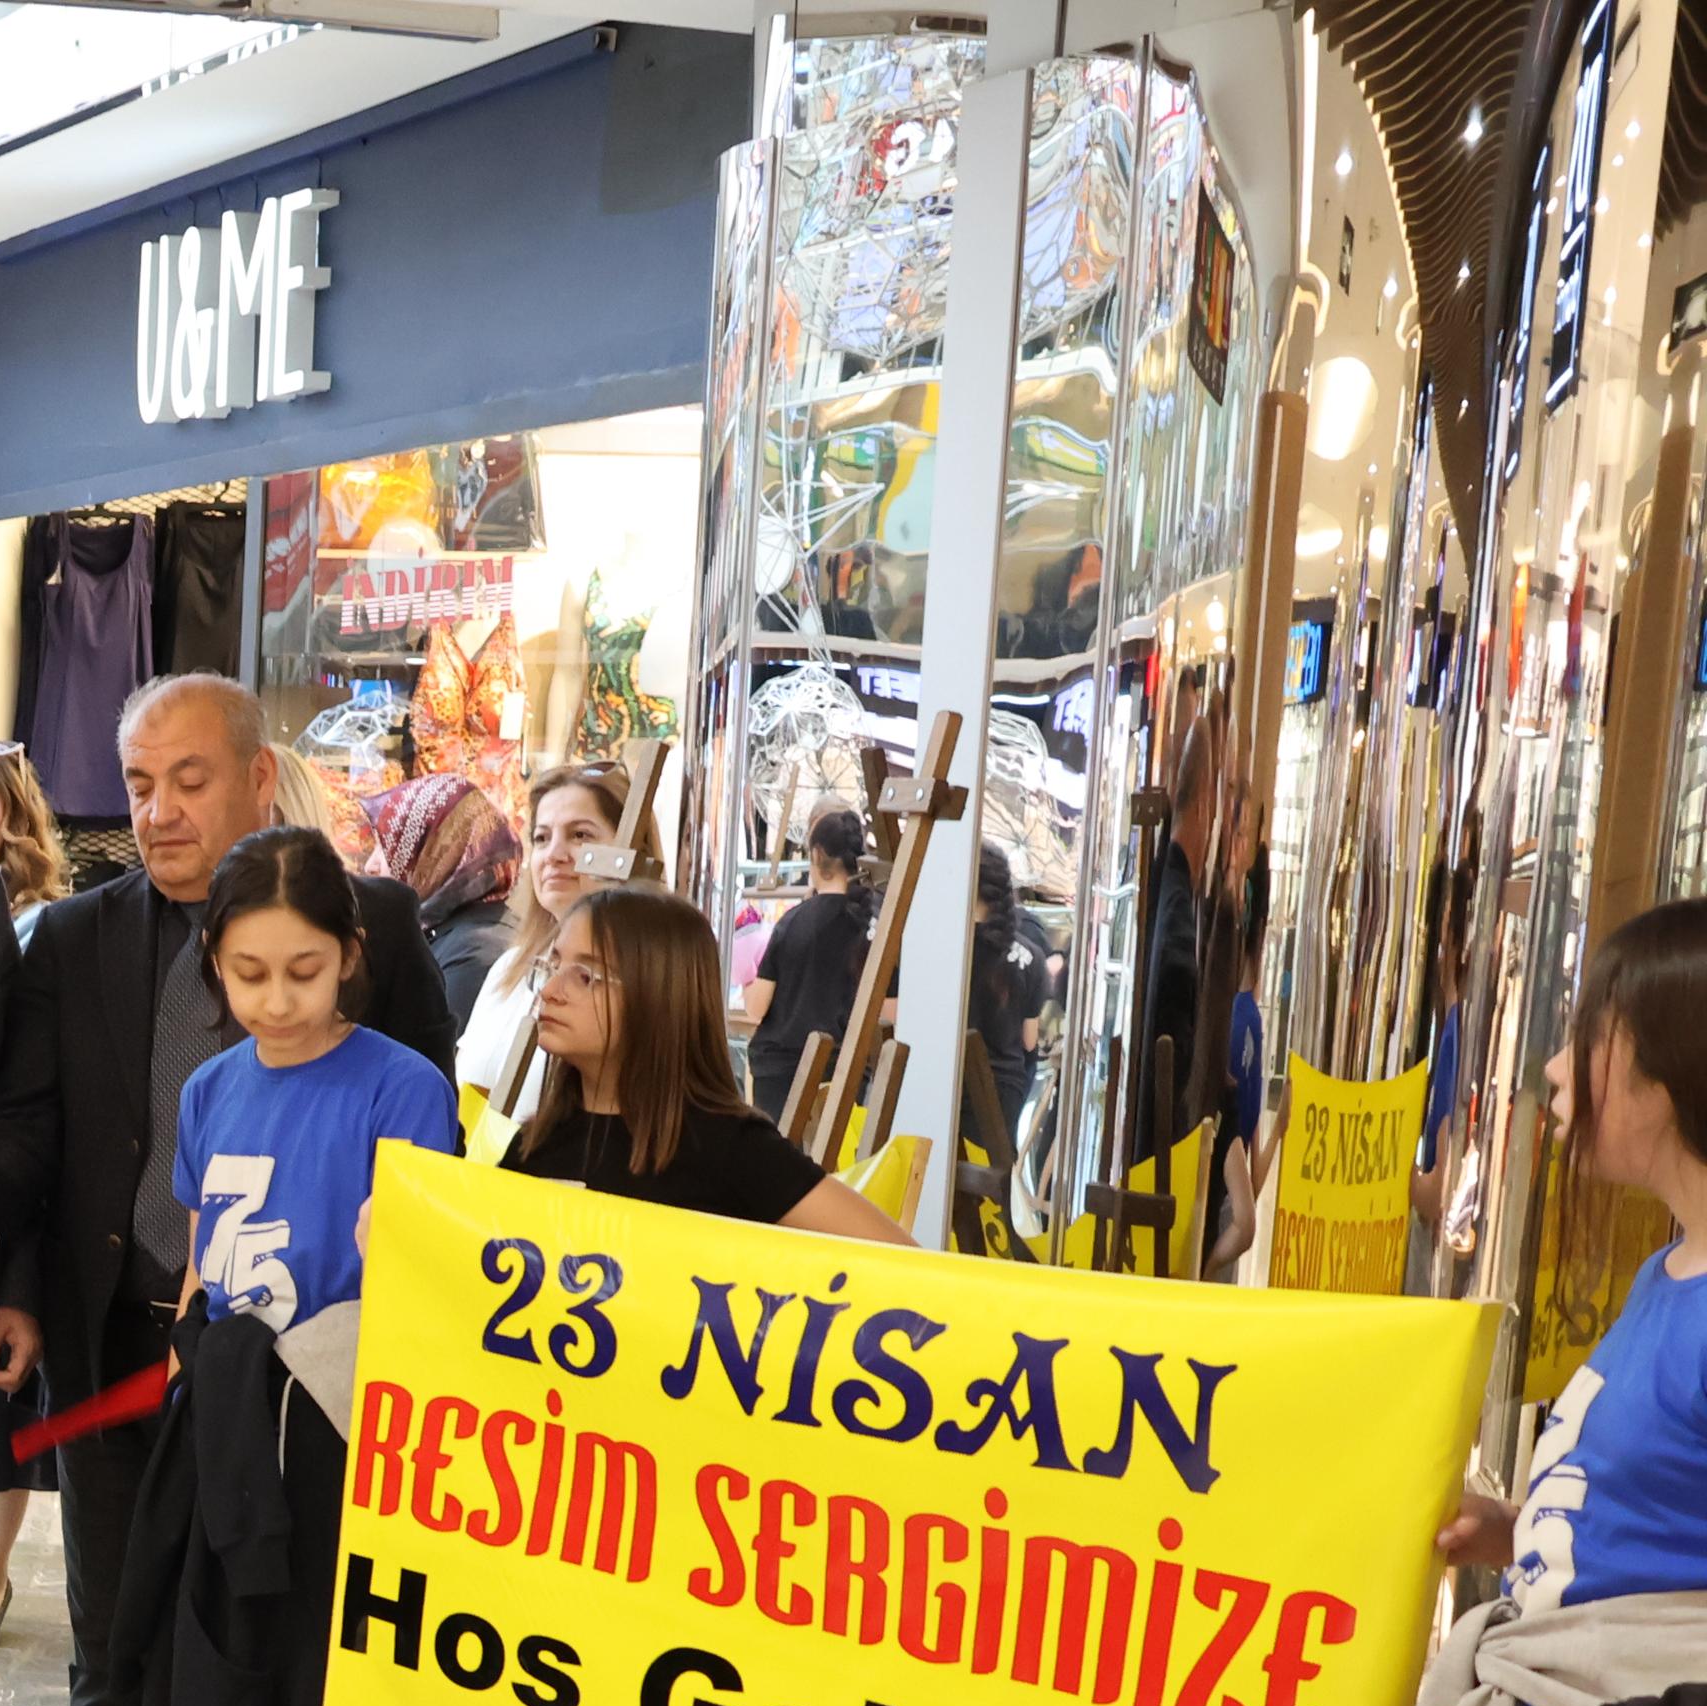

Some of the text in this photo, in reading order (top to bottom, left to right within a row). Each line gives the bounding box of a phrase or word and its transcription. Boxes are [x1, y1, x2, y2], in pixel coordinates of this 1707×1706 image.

[137, 188, 340, 424] U&ME
[199, 1153, 298, 1334] 75
[481, 1237, 1237, 1496] 23 NİSAN
[351, 1380, 658, 1583] RESİM
